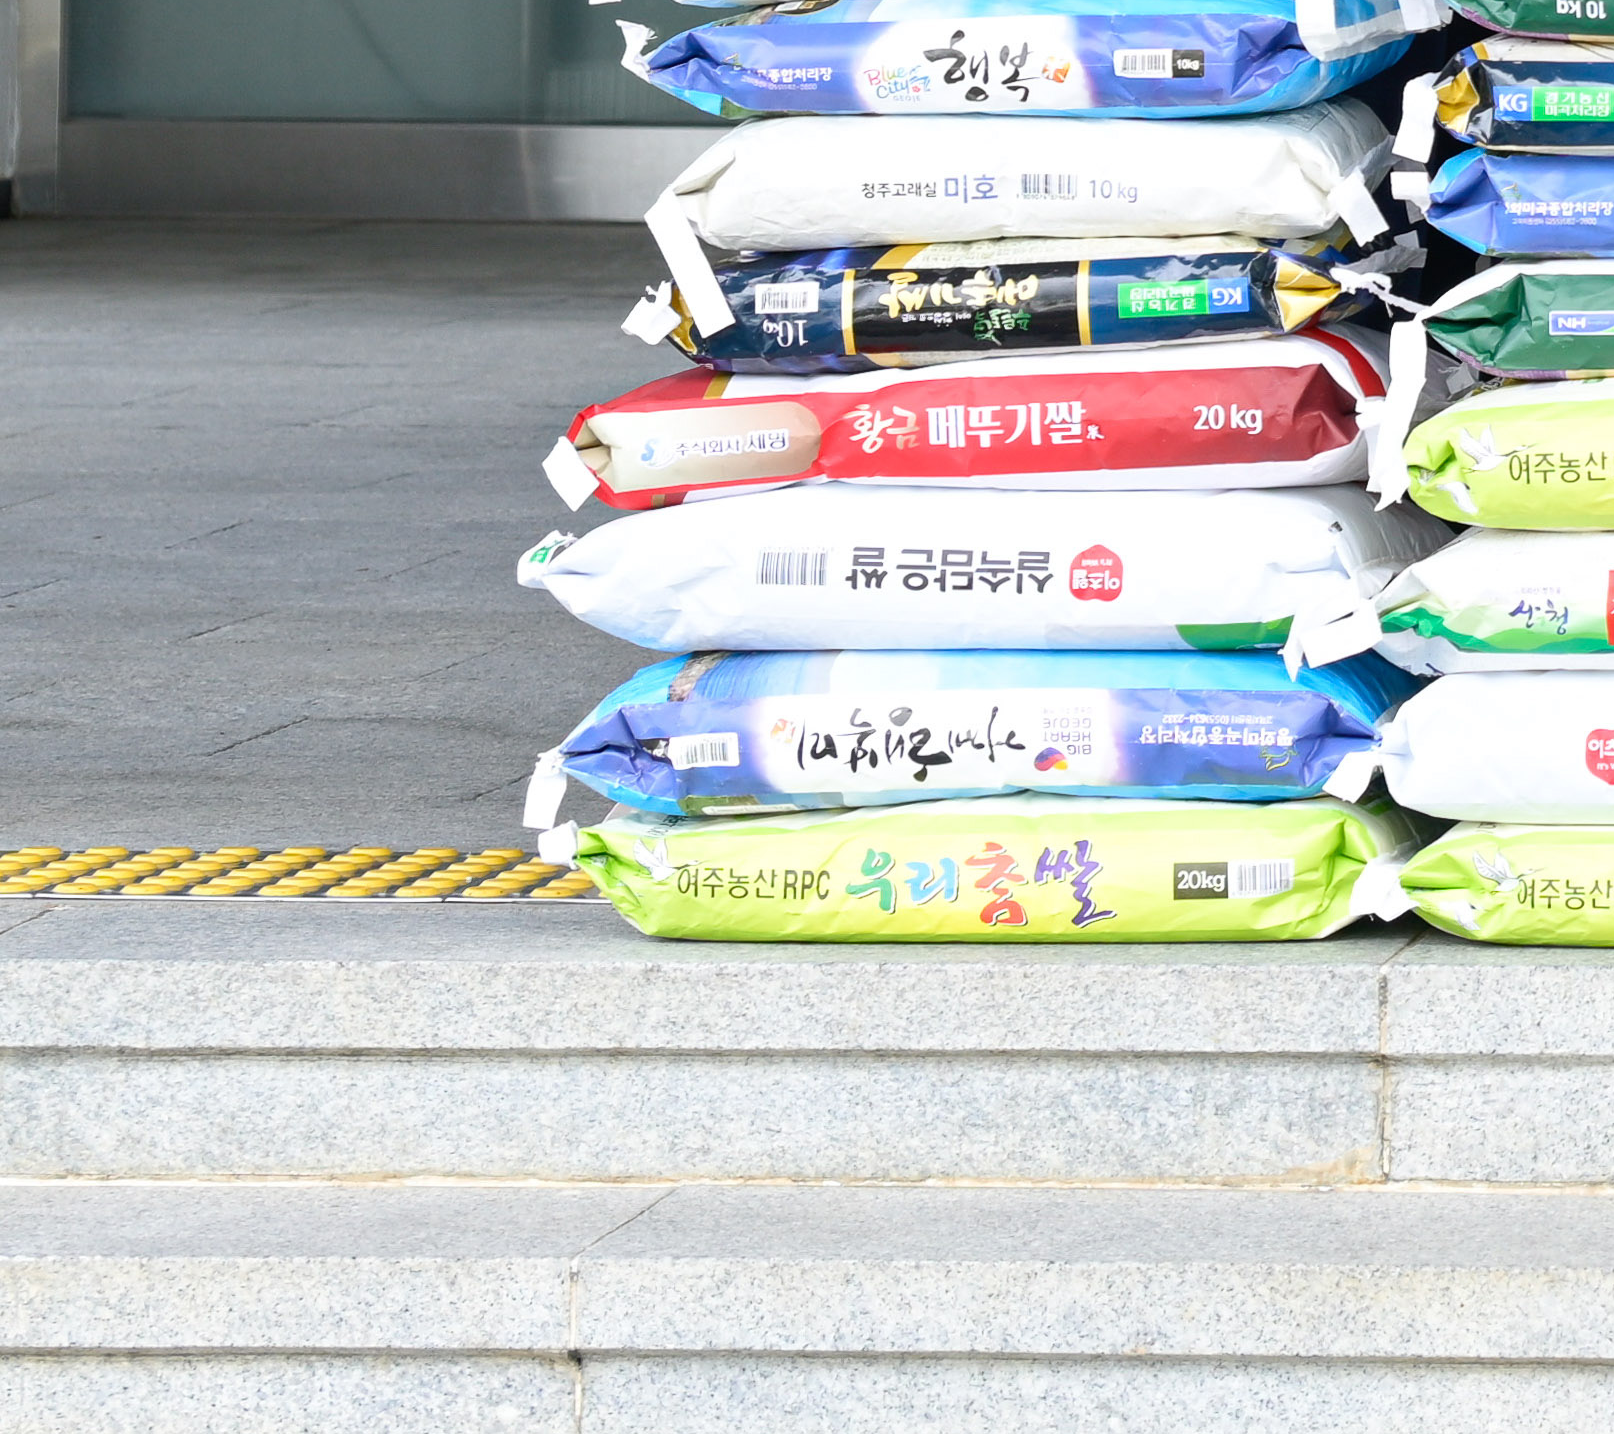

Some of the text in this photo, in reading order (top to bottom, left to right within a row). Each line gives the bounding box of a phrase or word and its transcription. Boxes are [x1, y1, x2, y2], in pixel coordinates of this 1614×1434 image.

[925, 30, 1042, 103] 행복
[1498, 94, 1528, 114] KG
[862, 175, 1138, 204] 청주고래실 미호 10 kg
[1555, 315, 1587, 330] NH
[850, 403, 1087, 453] 황금 메뚜기쌀
[1194, 404, 1263, 435] 20 kg
[1509, 451, 1607, 484] 여주농산
[846, 548, 1054, 595] 실속담은 쌀
[1074, 571, 1121, 593] 이츠웰
[677, 868, 830, 899] 여주농산 RPC
[1177, 868, 1226, 895] 20kg
